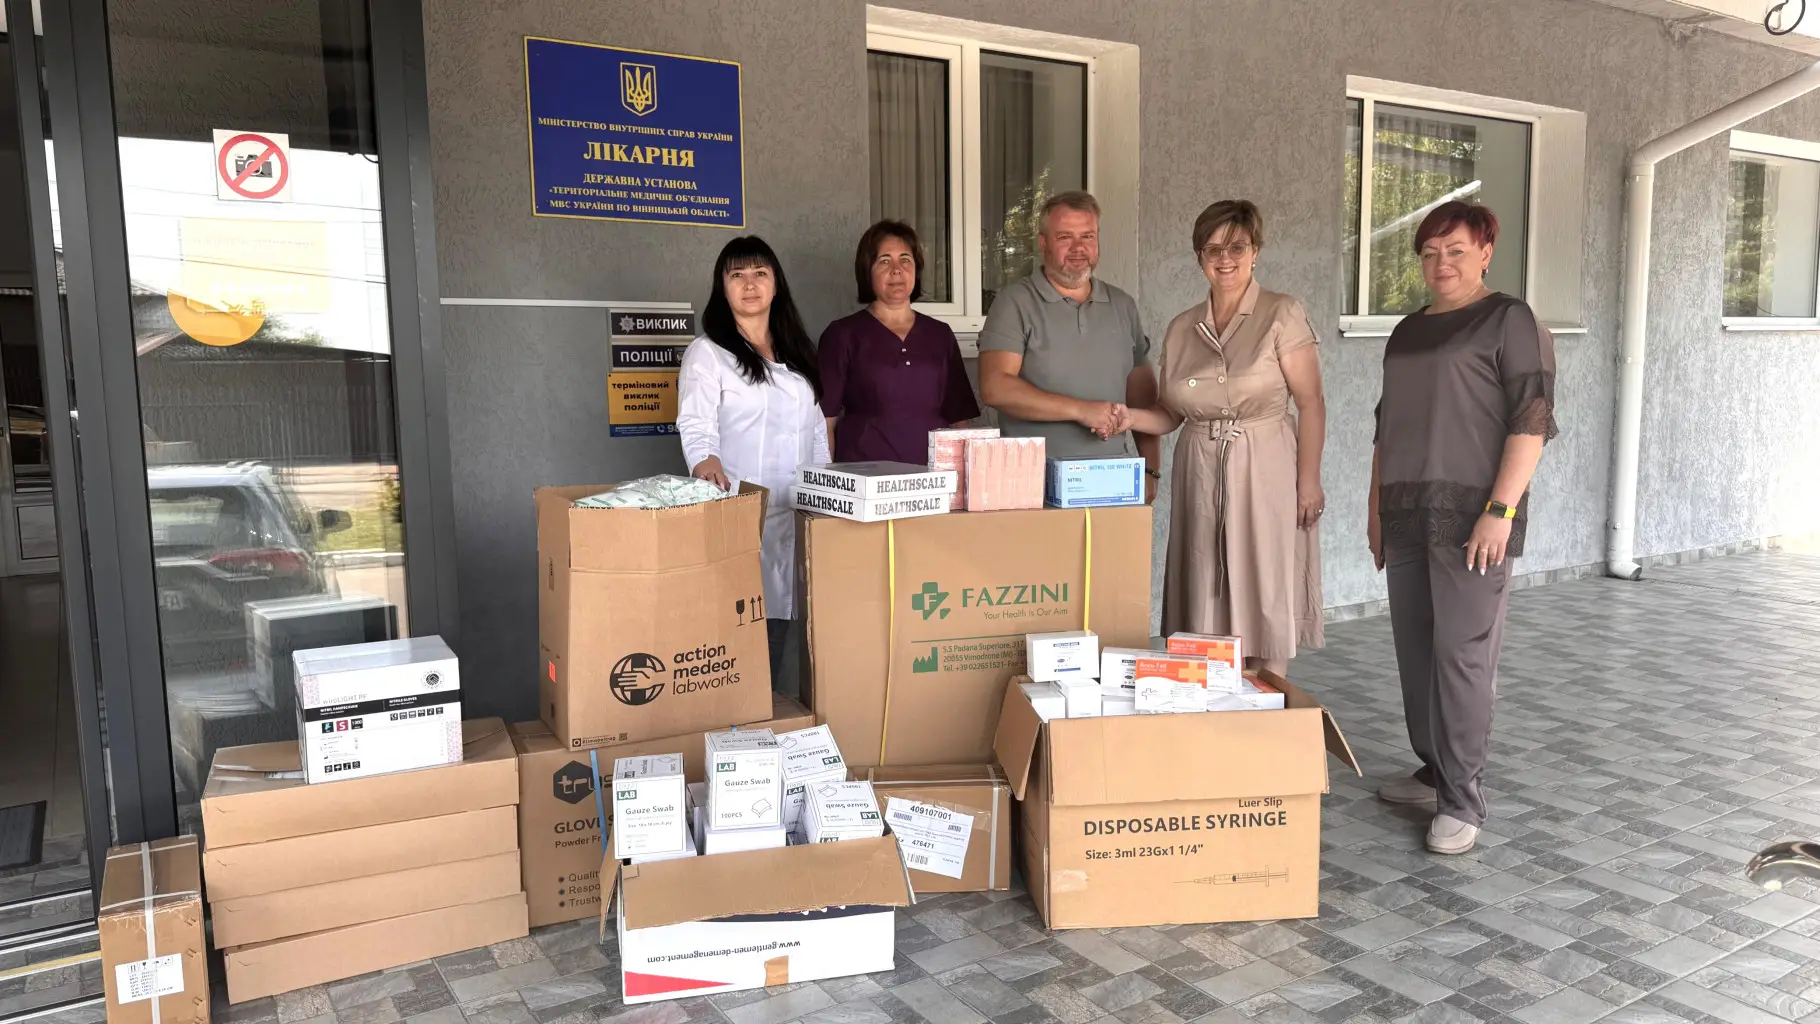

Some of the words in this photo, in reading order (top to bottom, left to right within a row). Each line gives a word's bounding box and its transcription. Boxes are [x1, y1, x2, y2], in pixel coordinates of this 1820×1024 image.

[538, 117, 607, 130] МІНІСТЕРСТВО
[609, 123, 665, 136] ВНУТРІШНІХ
[667, 129, 695, 139] СПРАВ
[697, 132, 733, 142] УКРАЇНИ
[583, 141, 695, 167] ЛІКАРНЯ
[583, 173, 641, 187] ДЕРЖАВНА
[644, 177, 697, 190] УСТАНОВА
[631, 191, 673, 202] МЕДИЧНЕ
[550, 200, 571, 209] МВС
[574, 201, 614, 211] УКРАЇНИ
[616, 203, 630, 212] ПО
[633, 204, 688, 216] ВІННИЦЬКІЙ
[636, 318, 688, 330] ВИКЛИК
[620, 348, 673, 364] ПОЛІЦІЇ
[612, 380, 670, 391] терміновий
[624, 402, 660, 411] поліції
[803, 470, 856, 492] HEALTHSCALE
[877, 476, 946, 493] HEALTHSCALE
[797, 492, 854, 515] HEALTHSCALE
[875, 497, 941, 516] HEALTHSCALE
[962, 582, 1068, 608] FAZZINI
[983, 611, 1000, 620] Your
[1002, 608, 1027, 619] Health
[1036, 607, 1051, 617] Our
[1053, 607, 1068, 616] Aim
[954, 644, 977, 652] Padana
[1012, 640, 1024, 648] 317
[673, 644, 726, 664] action
[964, 652, 999, 661] Vimodrone
[673, 656, 737, 679] medeor
[672, 670, 740, 695] labworks
[339, 722, 346, 730] S
[787, 753, 808, 761] Swab
[809, 748, 830, 757] Gauze
[823, 755, 840, 764] LAB
[718, 763, 735, 771] LAB
[750, 777, 771, 785] Swab
[618, 790, 636, 800] LAB
[1238, 797, 1261, 808] Luer
[1264, 796, 1283, 808] Slip
[626, 807, 651, 815] Gauze
[652, 804, 674, 812] Swab
[909, 805, 952, 820] 409107001
[1084, 815, 1201, 836] DISPOSABLE
[1206, 810, 1287, 830] SYRINGE
[555, 837, 589, 849] Powder
[911, 839, 935, 849] 476471
[1085, 848, 1112, 860] Size:
[1115, 847, 1136, 859] 3ml
[1139, 845, 1175, 857] 23Gx1
[647, 940, 801, 963] www.gentlemen-demenagement.com
